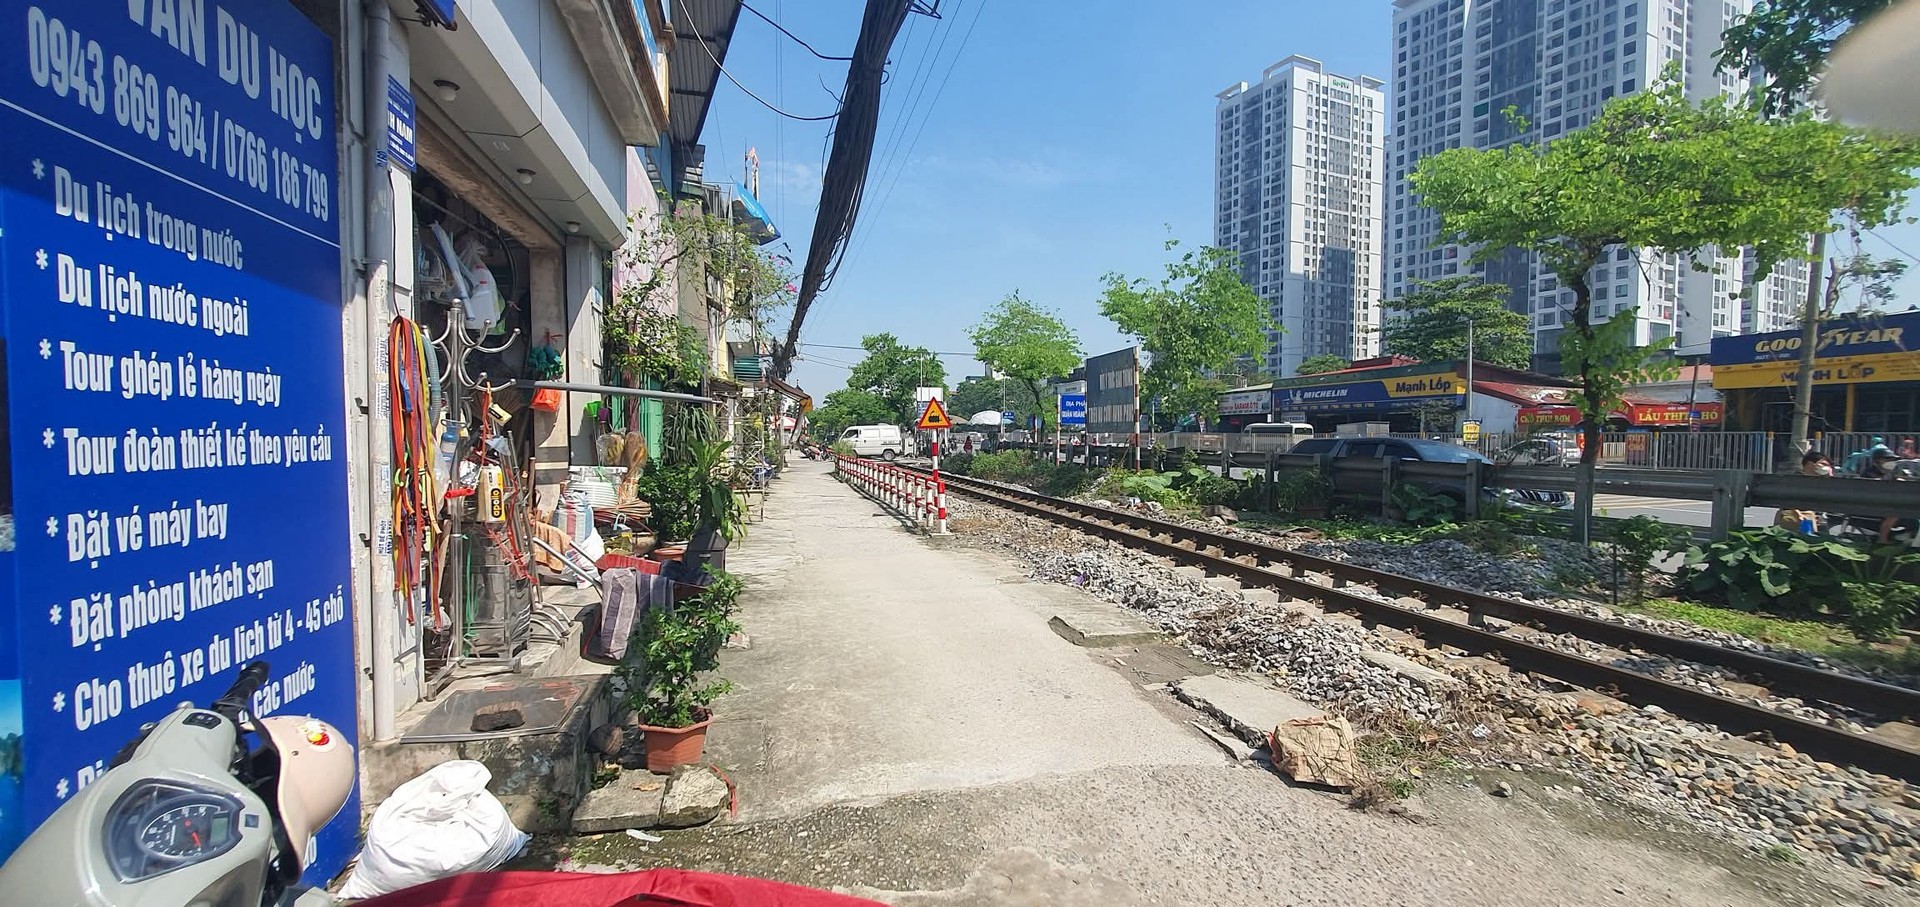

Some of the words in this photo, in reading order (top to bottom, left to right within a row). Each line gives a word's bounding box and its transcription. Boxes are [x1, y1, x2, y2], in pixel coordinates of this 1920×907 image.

[217, 6, 259, 99] DU
[270, 47, 321, 143] HỌC
[28, 7, 104, 114] 0943
[114, 55, 159, 140] 869
[167, 86, 206, 163] 964
[225, 119, 267, 192] 0766
[272, 147, 300, 208] 186
[303, 164, 328, 221] 799
[55, 166, 89, 223] Du
[97, 182, 140, 241] lịch
[146, 202, 197, 261] trong
[203, 225, 243, 270] nước
[58, 253, 92, 307] Du
[99, 264, 143, 322] lịch
[149, 283, 197, 326] nước
[202, 297, 248, 336] ngoài
[1755, 327, 1904, 352] GOOYEAR
[60, 341, 113, 391] Tour
[121, 351, 172, 400] ghép
[178, 352, 196, 397] lẻ
[201, 359, 243, 405] hàng
[247, 366, 281, 407] ngày
[1303, 388, 1348, 399] MICHELIN
[1396, 380, 1426, 394] Mạnh
[1429, 377, 1451, 392] Lốp
[63, 428, 116, 475] Tour
[124, 427, 175, 472] đoàn
[180, 422, 222, 469] thiết
[226, 422, 247, 466] kế
[249, 428, 281, 465] theo
[284, 429, 308, 467] yêu
[310, 424, 332, 461] cầu
[1701, 408, 1718, 421] HÓ
[67, 510, 110, 569] Đặt
[116, 505, 142, 552] vé
[149, 501, 191, 547] máy
[196, 499, 228, 539] bay
[491, 490, 502, 516] apollo
[70, 592, 113, 651] Đặt
[119, 580, 184, 638] phòng
[189, 562, 243, 611] khách
[247, 560, 273, 600] sạn
[74, 678, 122, 731] Cho
[128, 651, 175, 709] thuê
[181, 649, 204, 687] xe
[209, 634, 230, 675] du
[234, 620, 264, 671] lịch
[267, 611, 283, 650] từ
[285, 609, 294, 641] 4
[306, 599, 321, 633] 45
[323, 584, 343, 626] chỗ
[253, 679, 281, 719] các
[283, 661, 316, 704] nước
